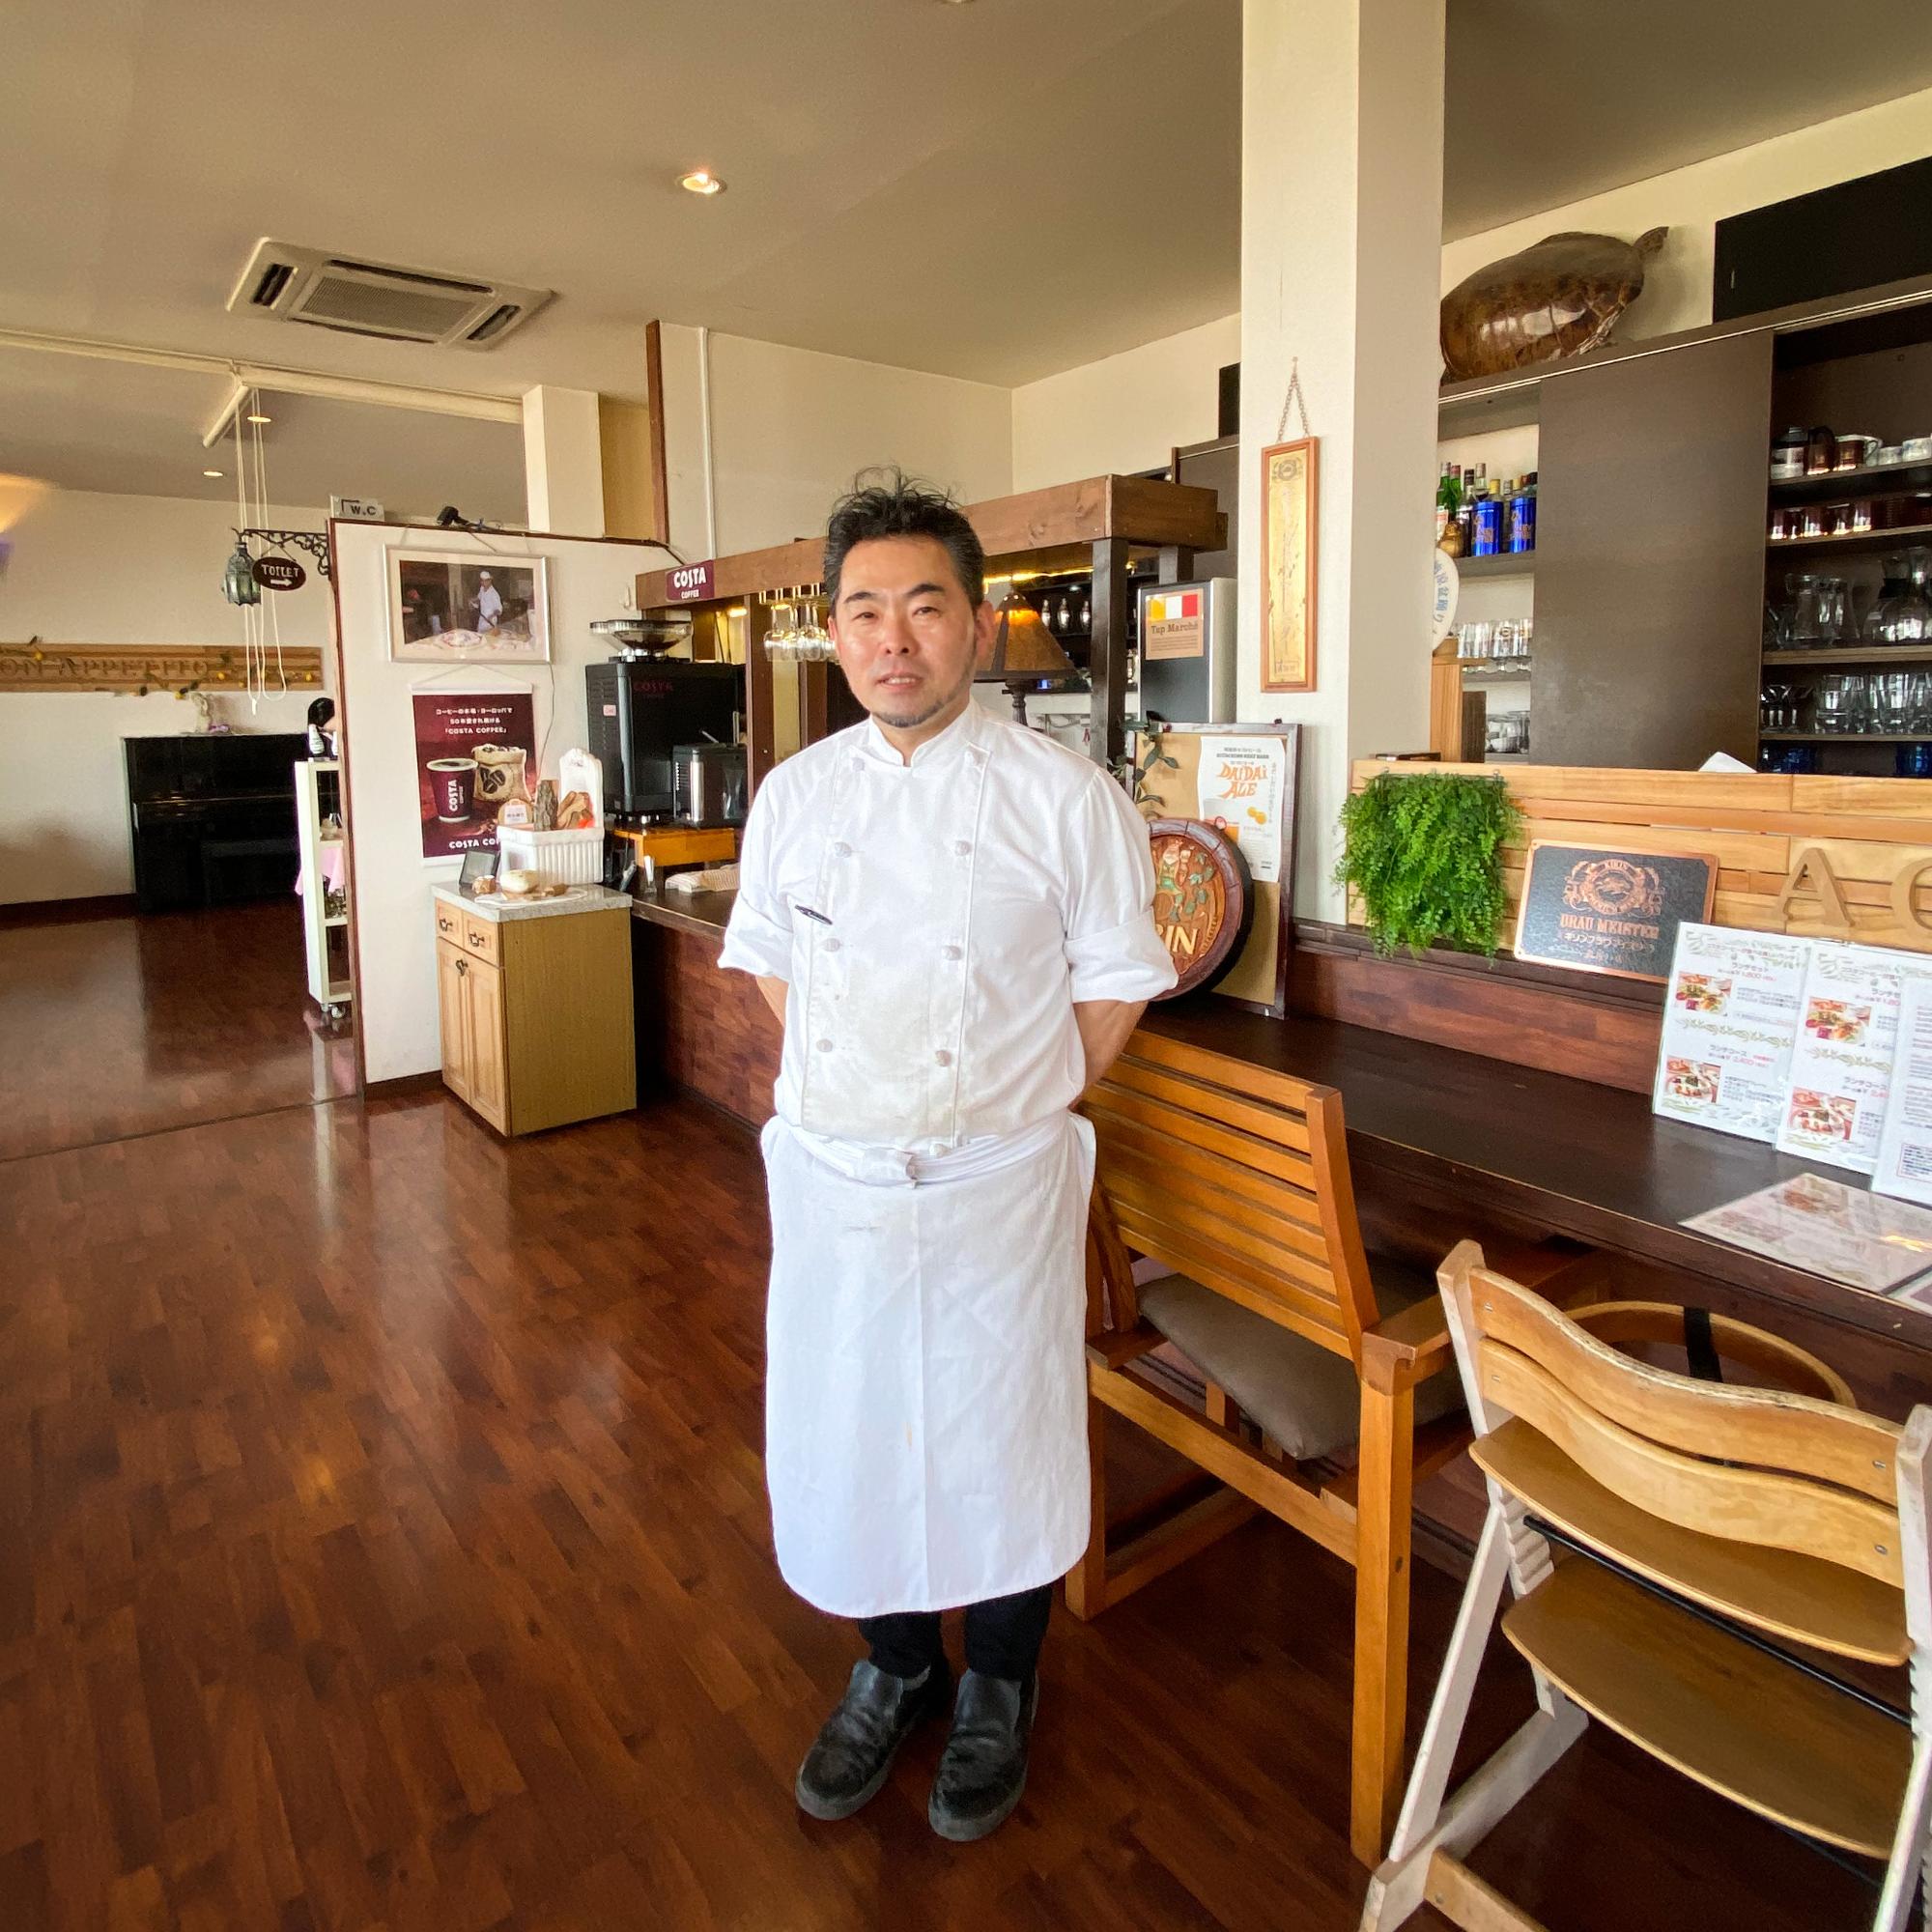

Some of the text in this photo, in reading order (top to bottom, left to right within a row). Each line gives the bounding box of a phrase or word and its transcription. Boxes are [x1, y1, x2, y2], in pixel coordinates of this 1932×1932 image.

[350, 505, 377, 516] W.C
[261, 564, 299, 577] TOILET
[673, 567, 706, 587] COSTA
[681, 589, 699, 599] COFFEE
[1151, 625, 1166, 635] Tap
[447, 779, 458, 812] COSTA
[1217, 781, 1258, 799] ALE
[448, 839, 480, 849] COSTA
